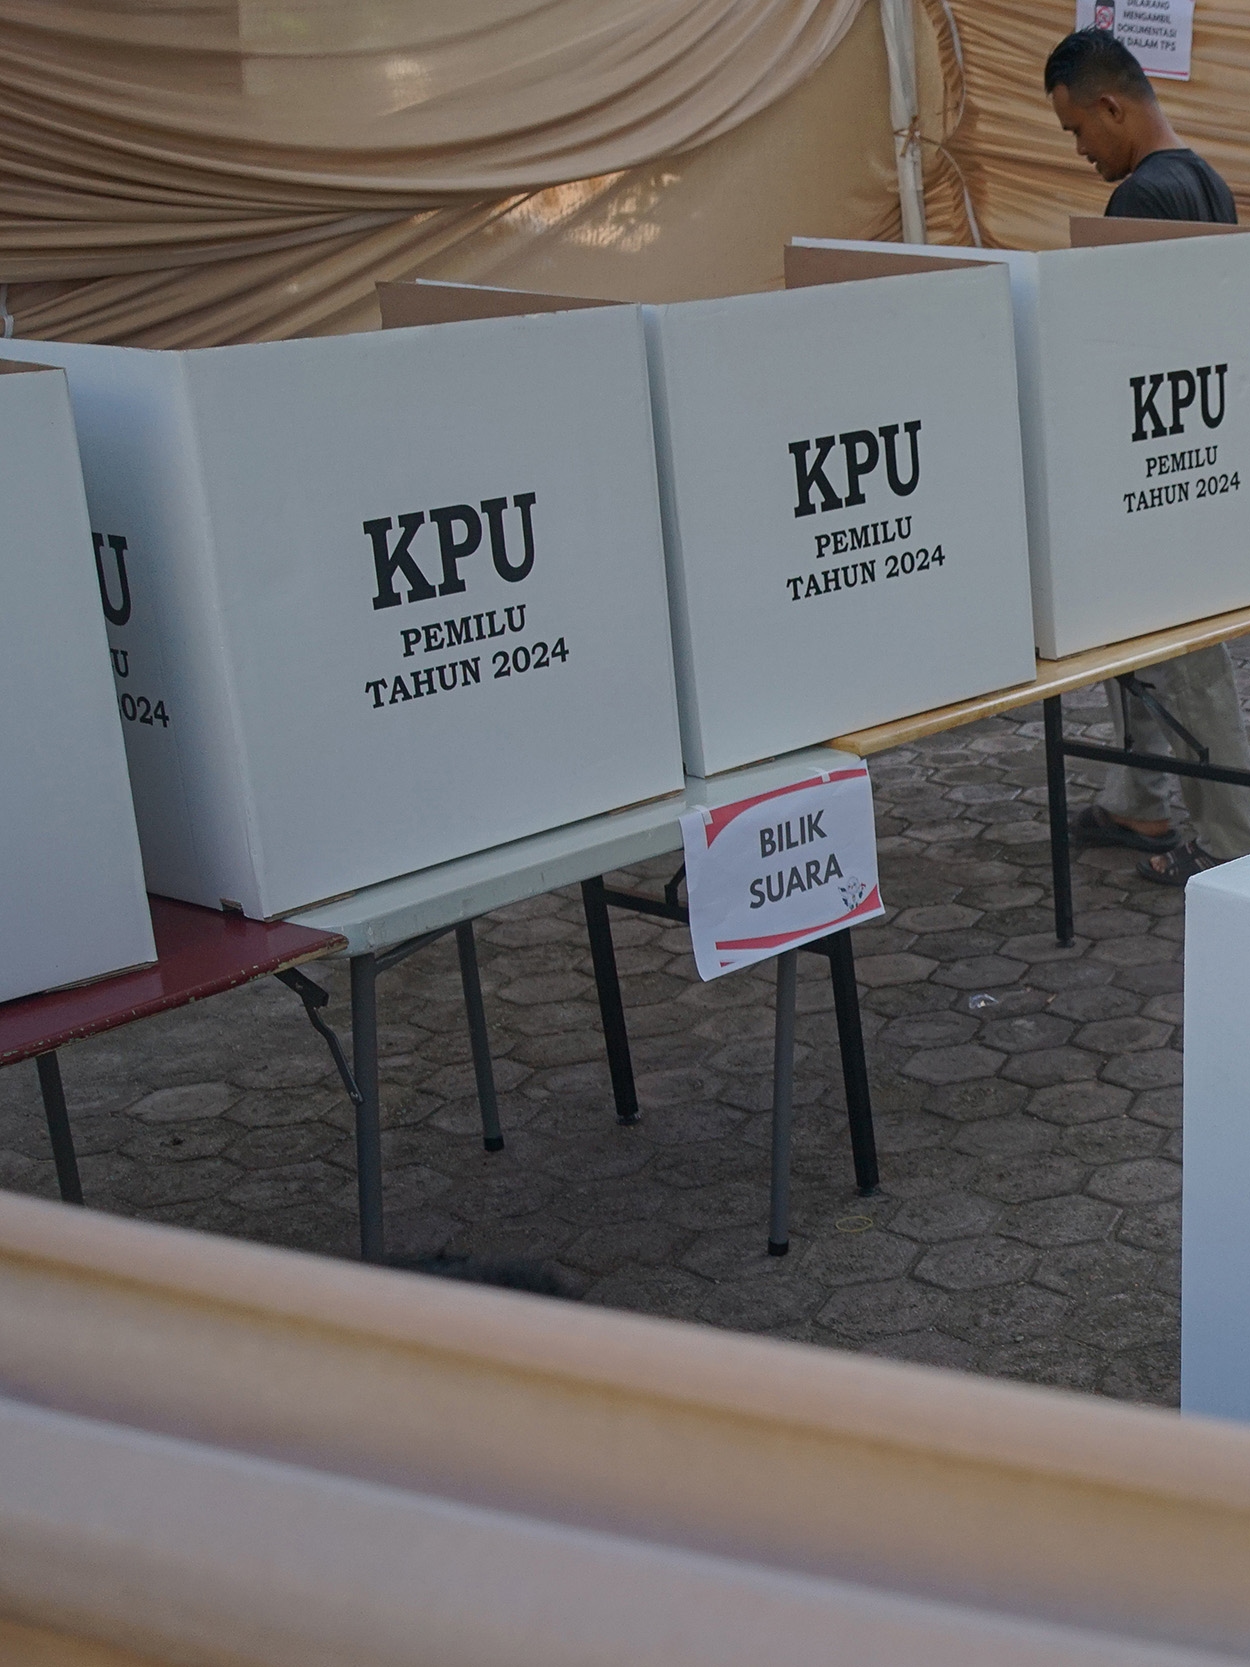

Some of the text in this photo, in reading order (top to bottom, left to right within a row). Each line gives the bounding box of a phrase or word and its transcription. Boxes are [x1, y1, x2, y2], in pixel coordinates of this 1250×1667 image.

[1117, 23, 1177, 38] DOKUMENTASI
[1123, 10, 1171, 24] MENGAMBIL
[1126, 37, 1159, 49] DALAM
[1160, 40, 1176, 51] TPS
[1129, 363, 1228, 443] KPU
[788, 419, 922, 519] KPU
[1145, 445, 1218, 478] PEMILU
[1123, 471, 1241, 514] TAHUN 2024
[362, 491, 537, 611] KPU
[814, 515, 912, 559] PEMILU
[786, 544, 946, 602] TAHUN 2024
[400, 603, 527, 658] PEMILU
[364, 636, 570, 709] TAHUN 2024
[116, 692, 170, 728] 024
[759, 809, 828, 859] BILIK
[749, 853, 844, 909] SUARA
